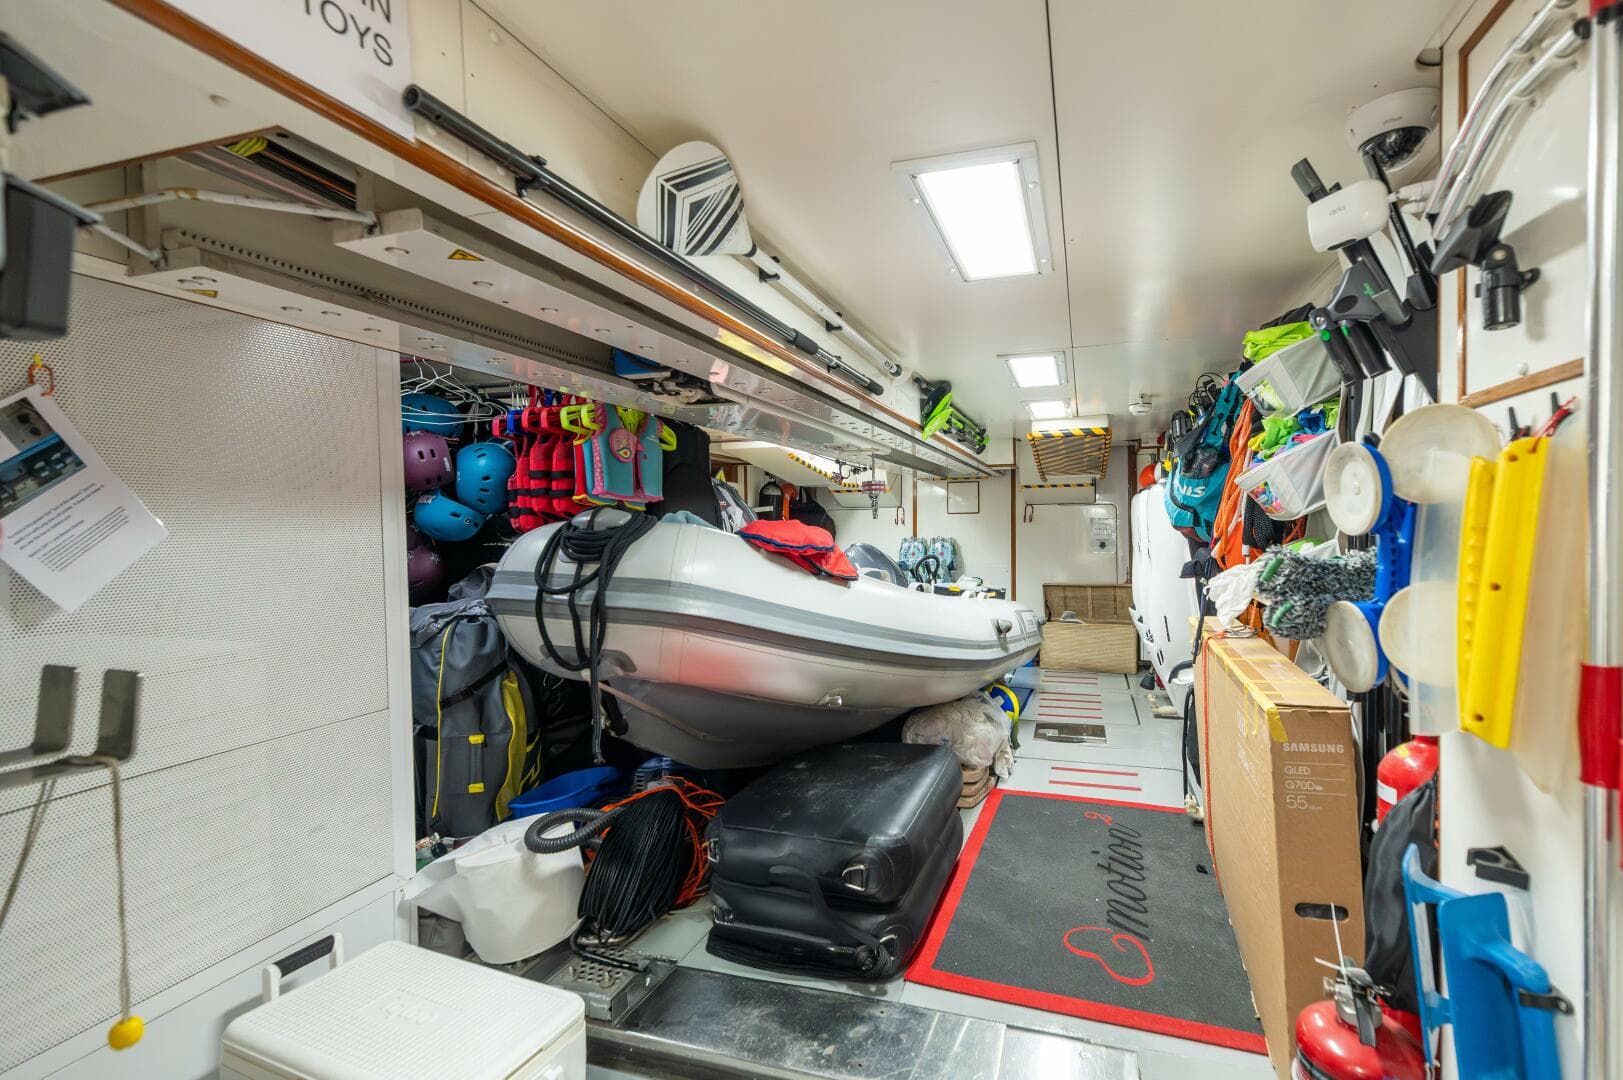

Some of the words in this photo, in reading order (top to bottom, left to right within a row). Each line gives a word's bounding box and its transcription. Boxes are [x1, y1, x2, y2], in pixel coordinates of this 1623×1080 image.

[1282, 742, 1345, 754] SAMSUNG
[1284, 766, 1311, 776] QLED
[1286, 796, 1308, 810] 55
